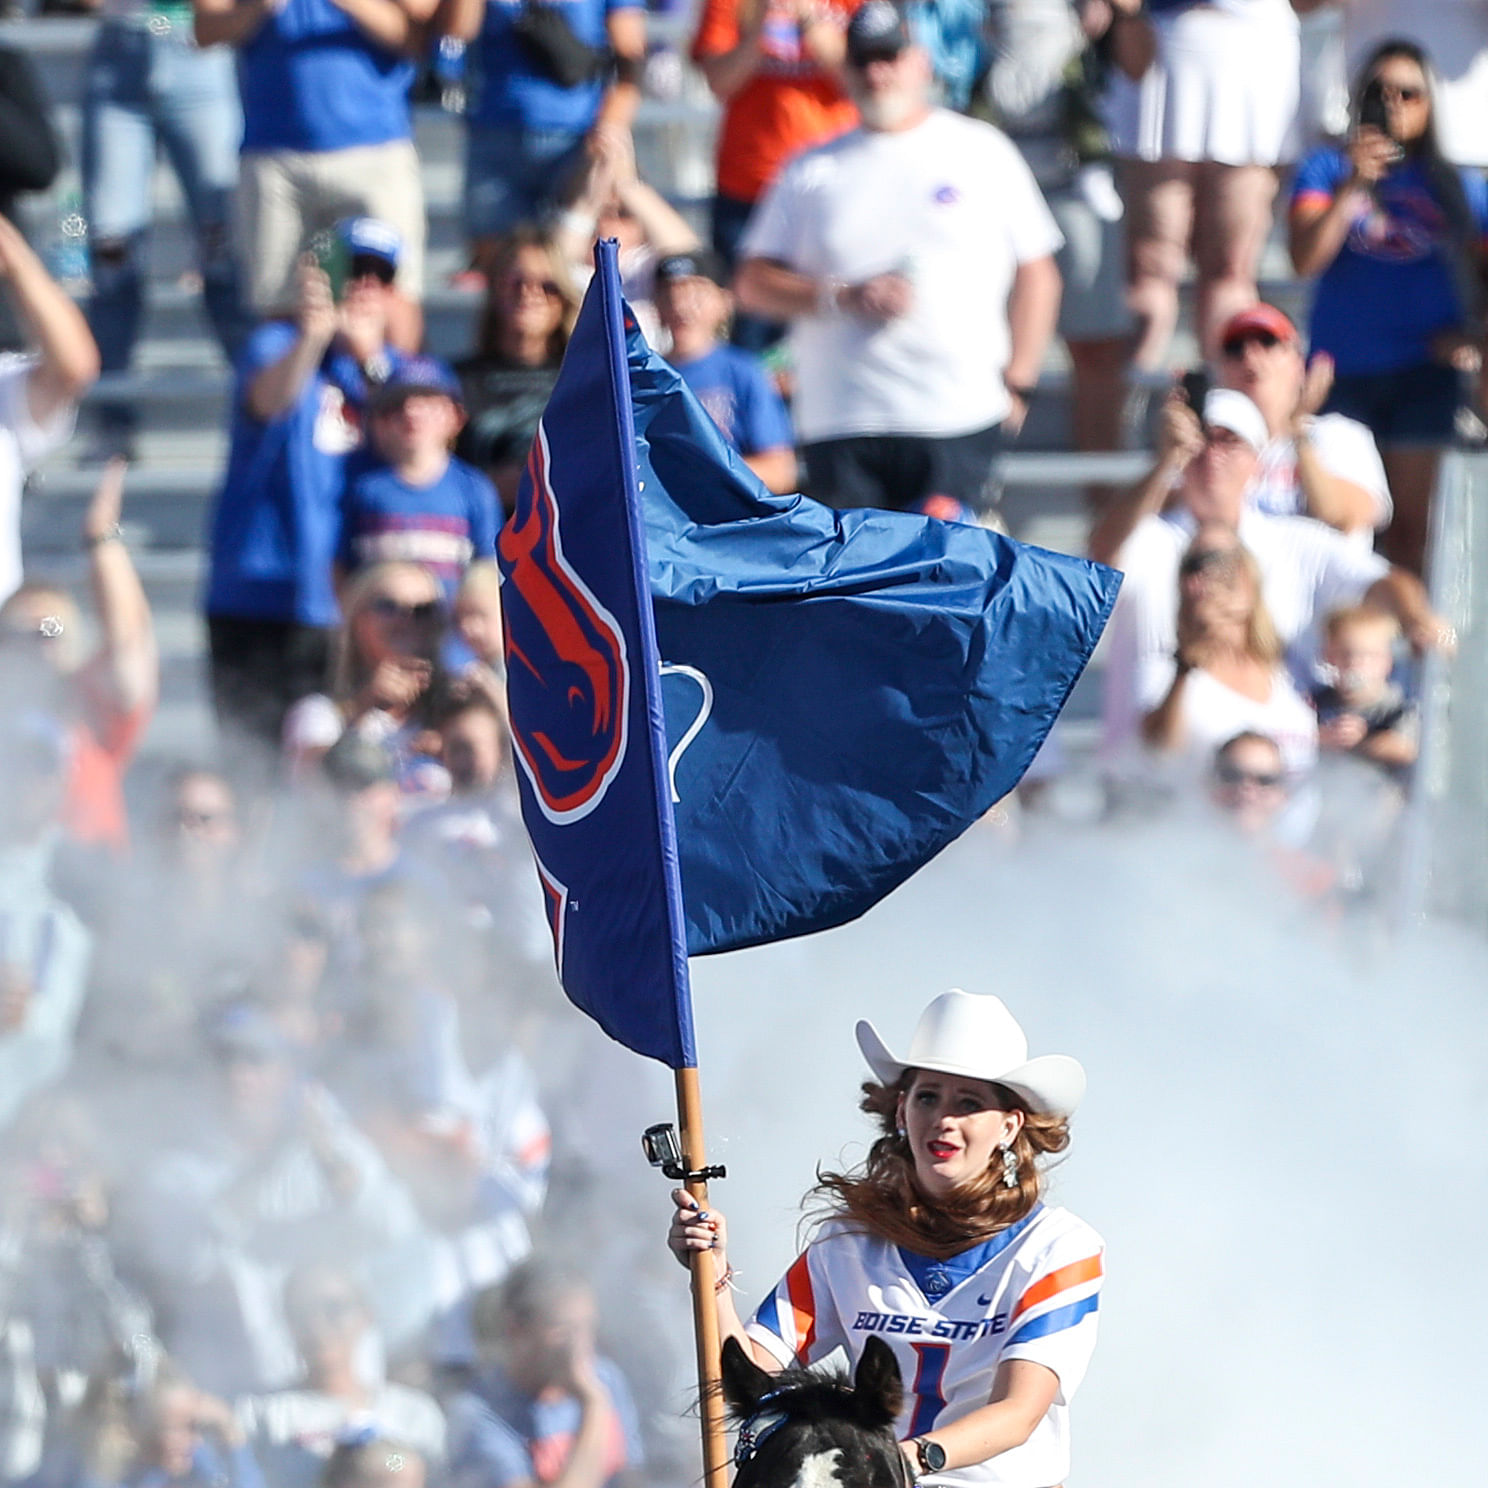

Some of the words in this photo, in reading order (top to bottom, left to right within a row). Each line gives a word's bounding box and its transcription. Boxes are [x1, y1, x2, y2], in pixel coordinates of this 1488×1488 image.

[852, 1311, 928, 1335] BOISE
[932, 1313, 1008, 1341] STATE
[898, 1342, 952, 1443] 1
